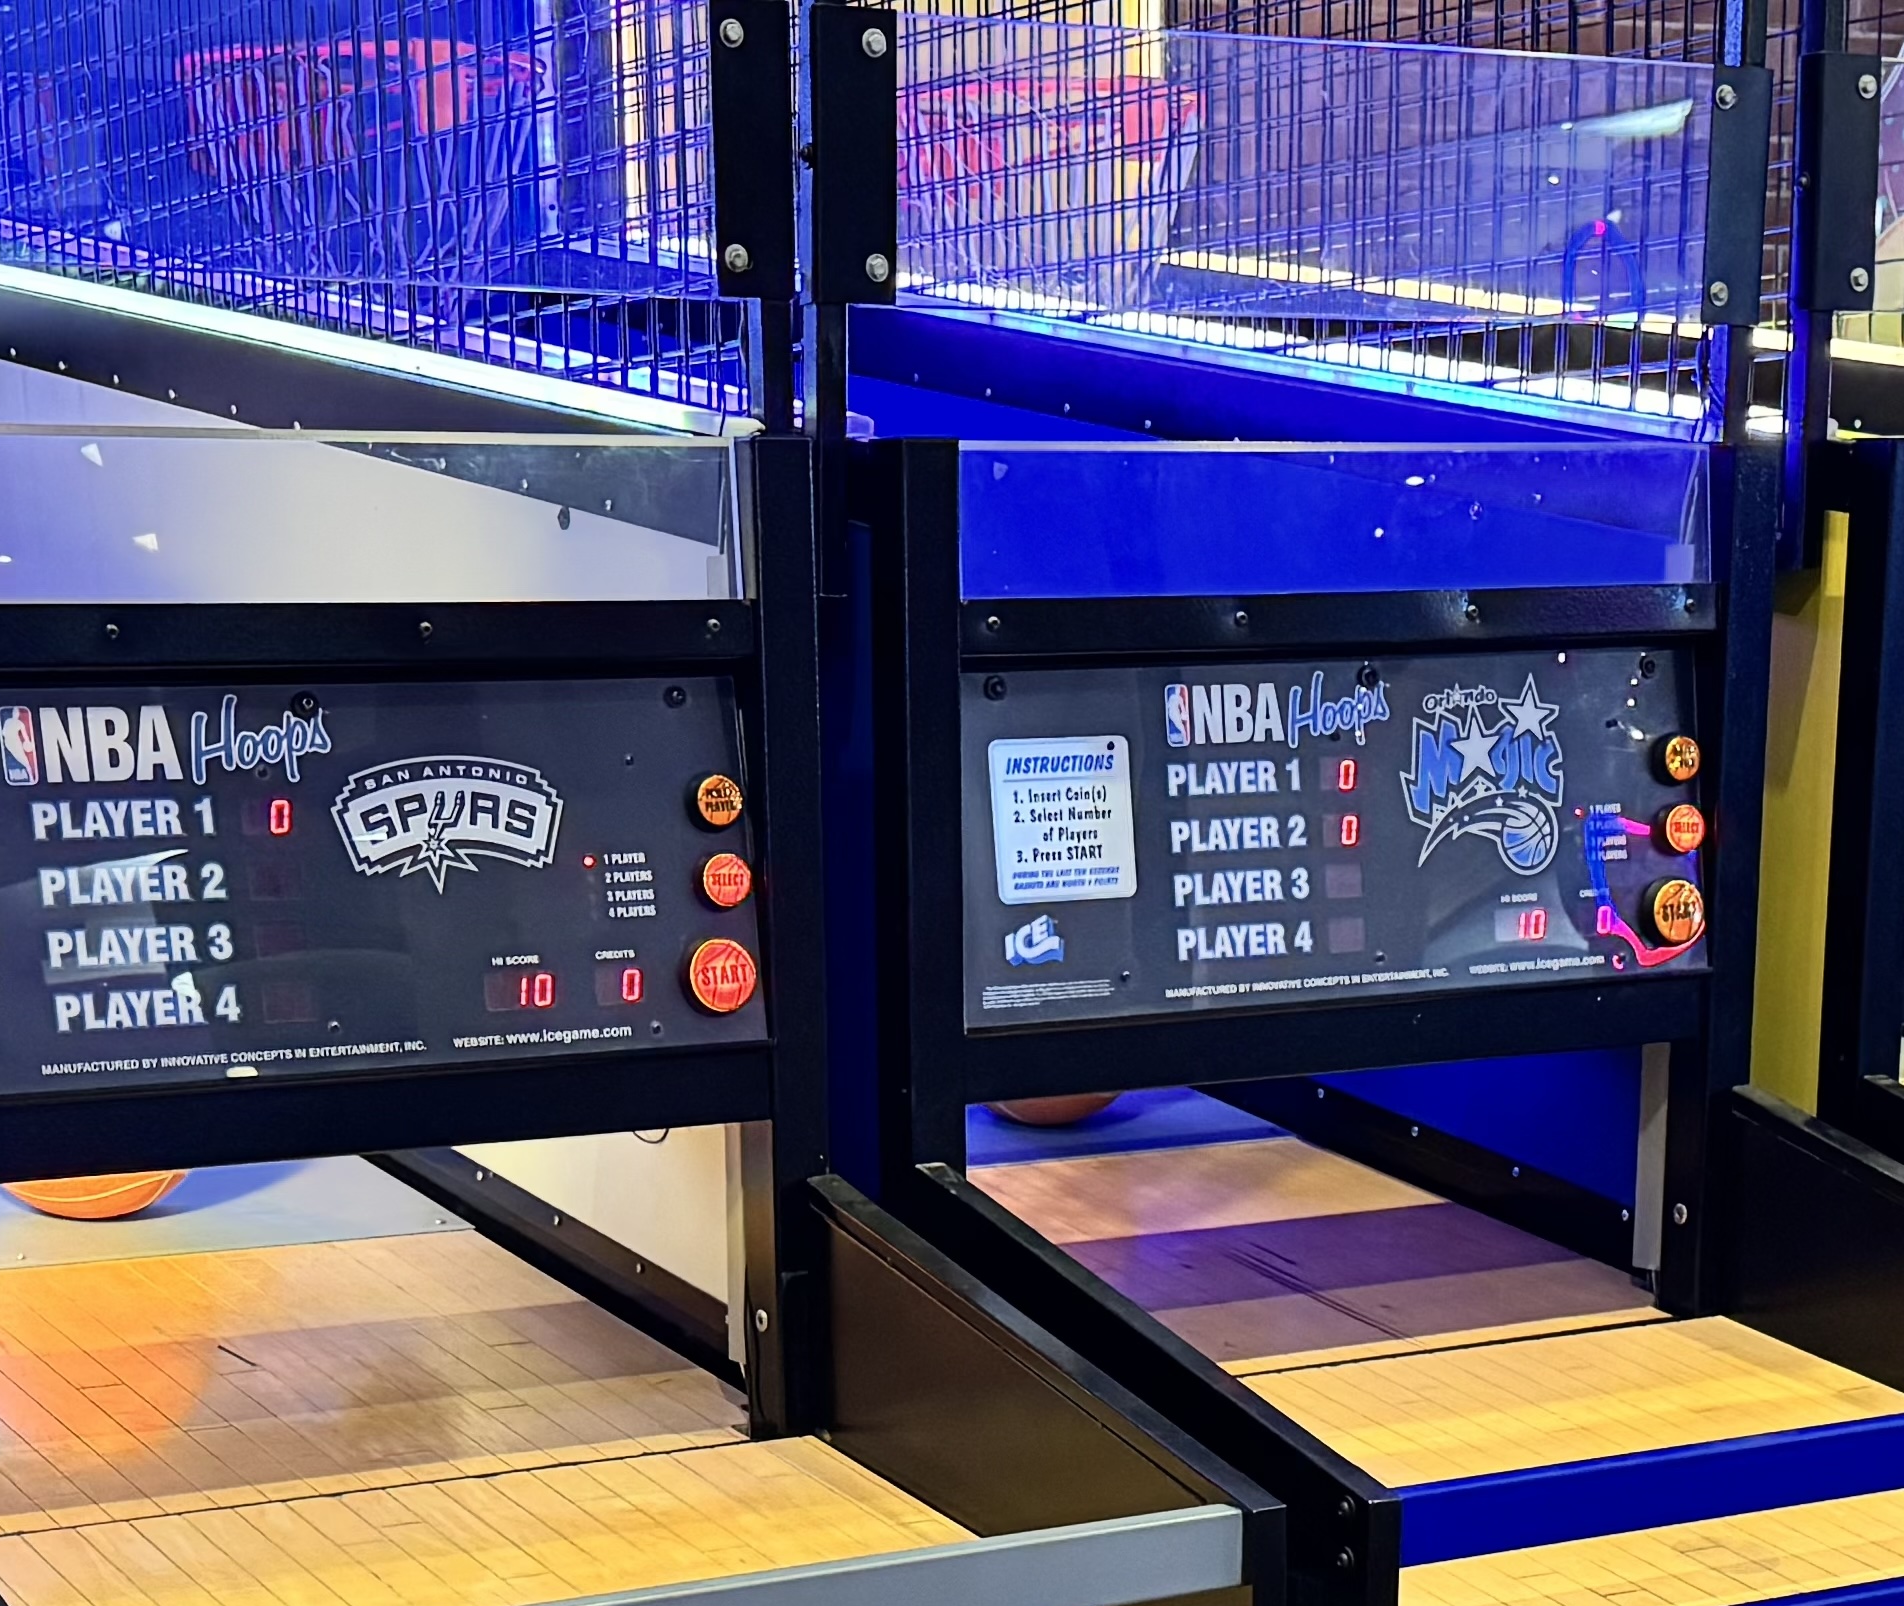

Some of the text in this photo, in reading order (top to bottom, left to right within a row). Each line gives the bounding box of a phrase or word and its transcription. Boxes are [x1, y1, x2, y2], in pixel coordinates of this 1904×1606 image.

[1192, 671, 1390, 748] NBA Hoops
[39, 694, 332, 785] NBA Hoops
[364, 765, 527, 790] SAN ANTONIO
[1167, 761, 1279, 796] PLAYER
[1285, 758, 1302, 791] 1
[32, 799, 187, 840] PLAYER
[195, 796, 217, 836] 1
[359, 791, 537, 845] SPURS
[1170, 816, 1283, 854] PLAYER
[1287, 815, 1308, 847] 2
[39, 863, 228, 908] PLAYER 2
[712, 873, 744, 886] SELECT
[1173, 867, 1310, 907] PLAYER 3
[1005, 914, 1060, 961] ICE
[1177, 921, 1313, 961] PLAYER 4
[1518, 908, 1547, 940] 10
[46, 924, 234, 970] PLAYER 3
[520, 973, 555, 1008] 10
[622, 967, 643, 1002] 0
[701, 964, 748, 986] START
[54, 984, 241, 1033] PLAYER 4
[41, 1058, 139, 1076] MANUFACTURED
[142, 1057, 158, 1069] BY
[231, 1049, 293, 1063] CONCEPTS
